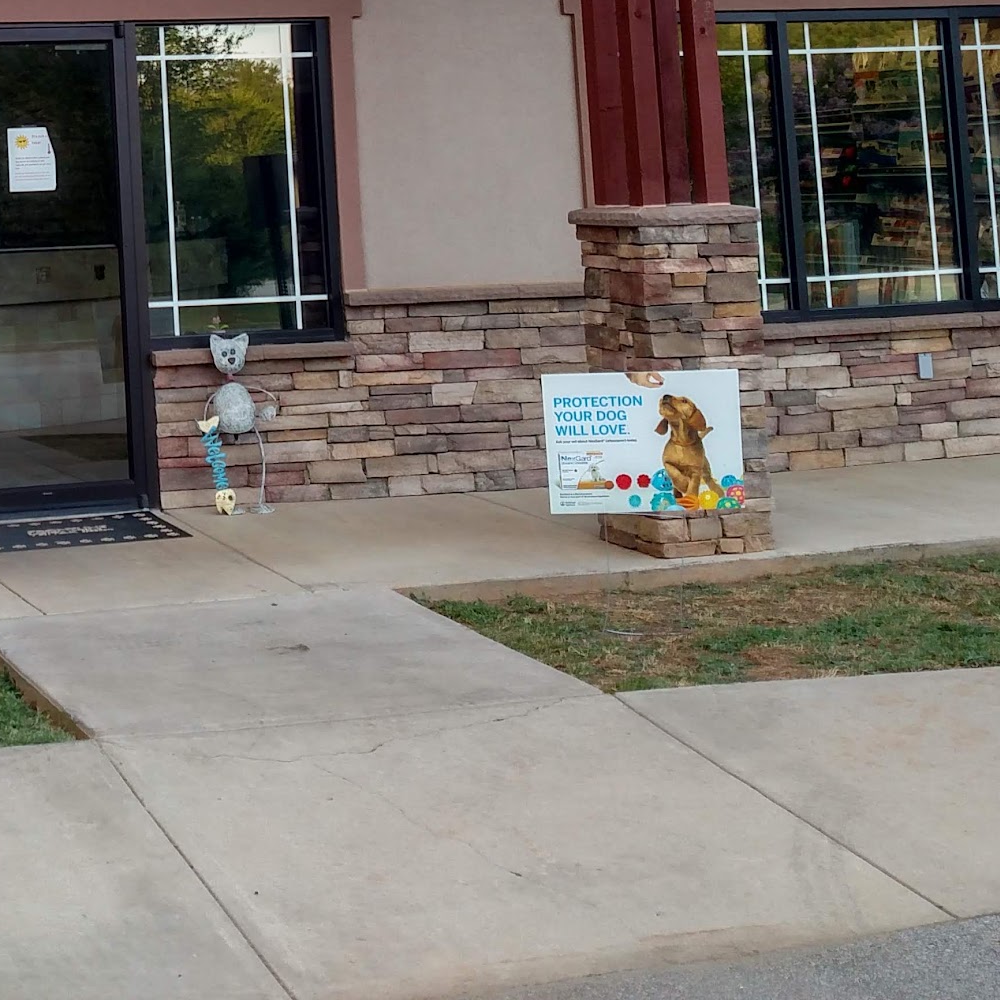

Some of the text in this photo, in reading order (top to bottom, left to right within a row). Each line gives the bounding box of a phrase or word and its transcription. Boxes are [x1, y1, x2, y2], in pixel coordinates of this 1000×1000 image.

[553, 395, 643, 408] PROTECTION
[554, 410, 627, 422] YOUR DOG
[555, 424, 630, 436] WILL LOVE.
